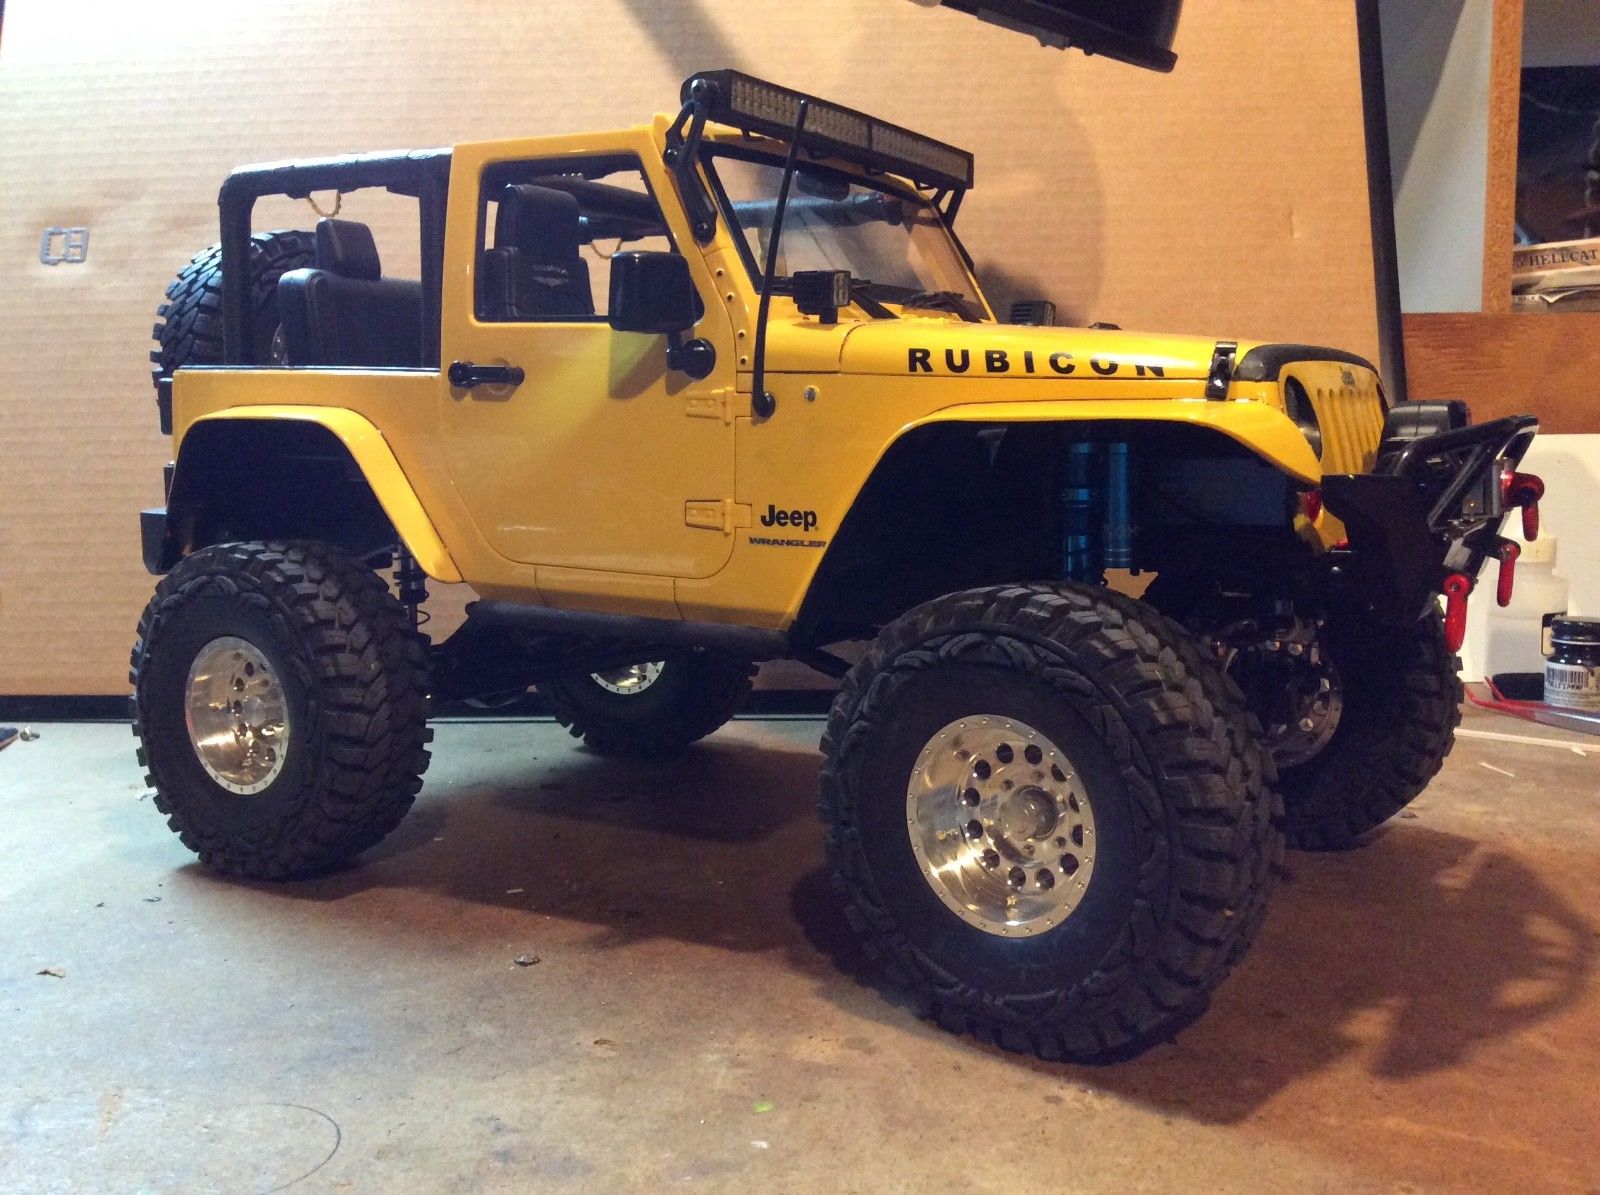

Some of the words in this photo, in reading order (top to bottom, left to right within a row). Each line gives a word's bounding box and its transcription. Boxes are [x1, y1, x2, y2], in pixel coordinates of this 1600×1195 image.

[1529, 249, 1598, 267] HELLCAT
[760, 504, 817, 532] Jeep
[749, 536, 826, 548] WRANGLER
